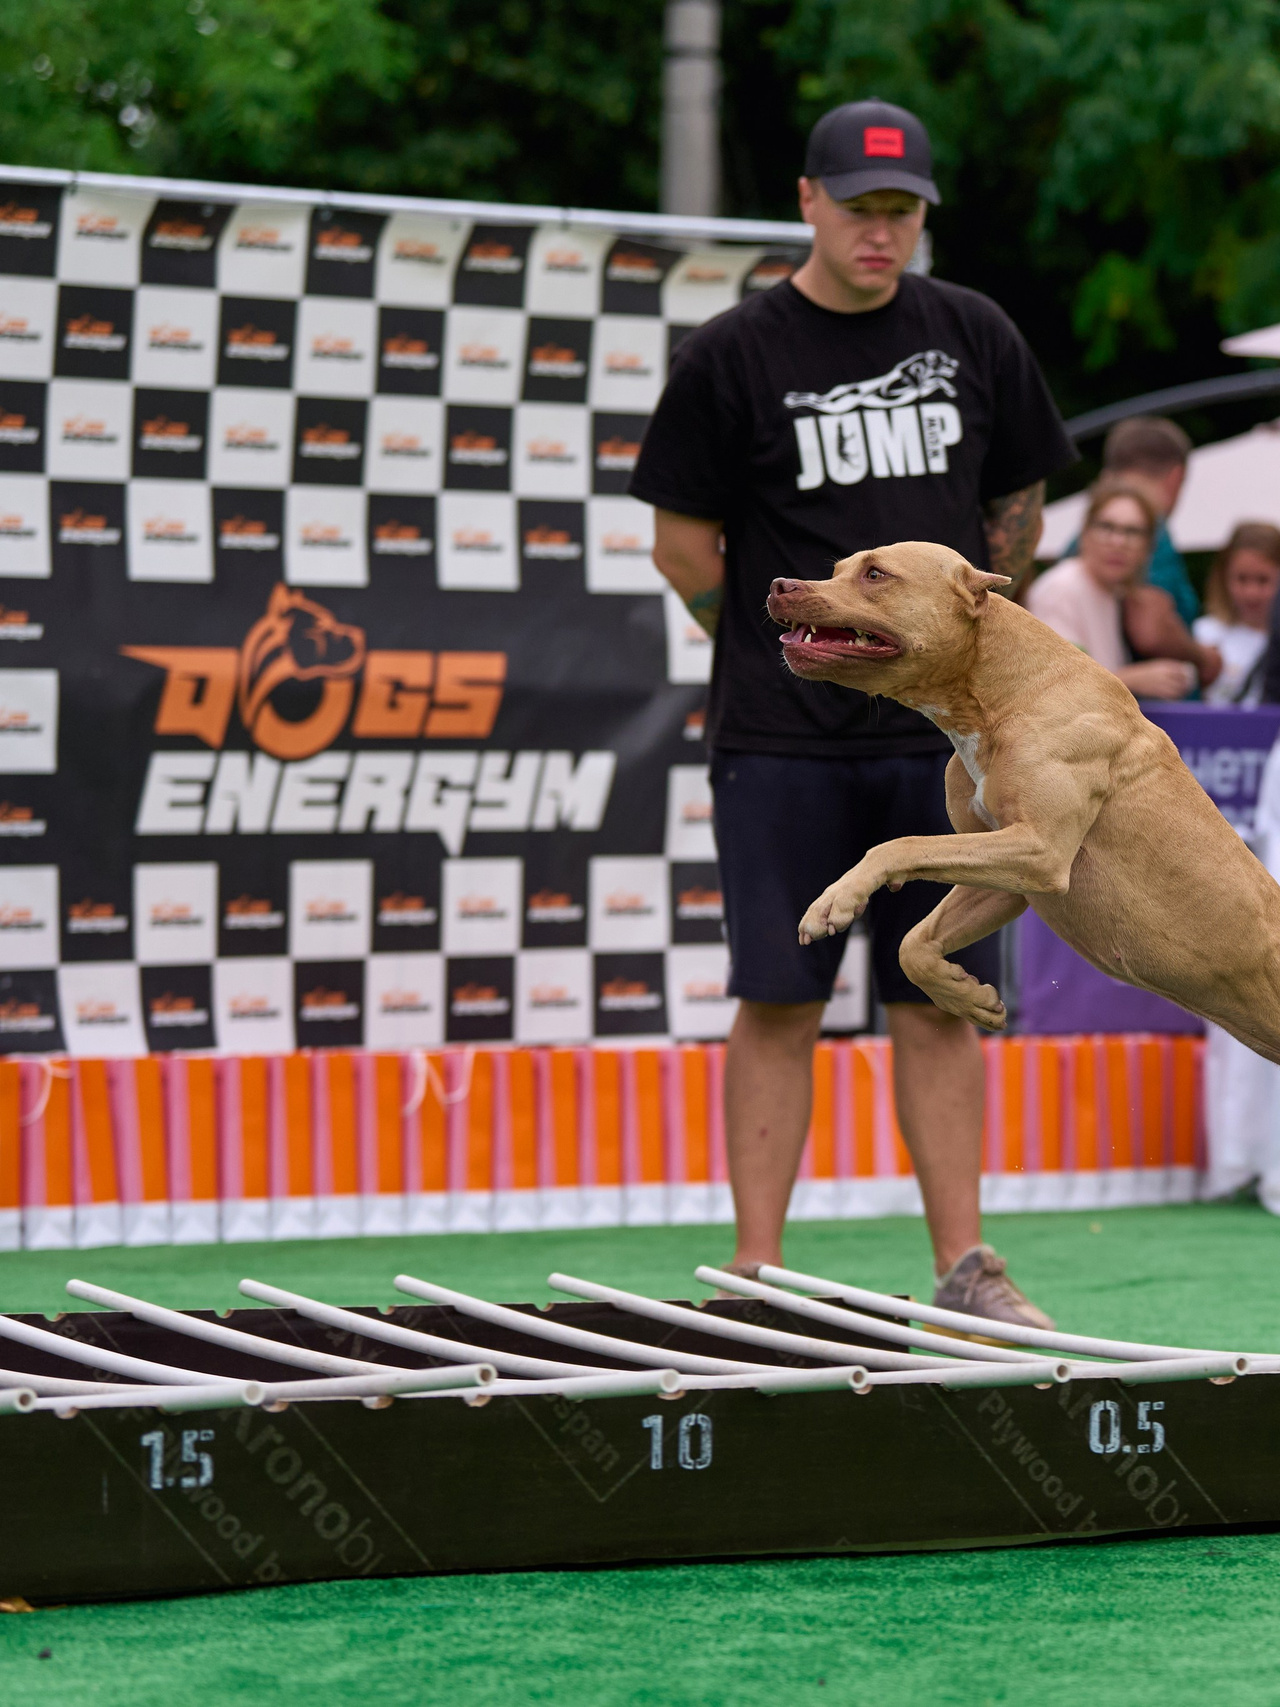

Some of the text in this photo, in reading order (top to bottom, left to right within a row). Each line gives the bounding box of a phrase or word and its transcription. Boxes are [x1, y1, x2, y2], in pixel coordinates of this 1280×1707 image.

[794, 401, 963, 492] JUMP
[119, 632, 508, 760] DOGS
[135, 751, 618, 857] ENERGYM
[1089, 1399, 1166, 1455] 0.5
